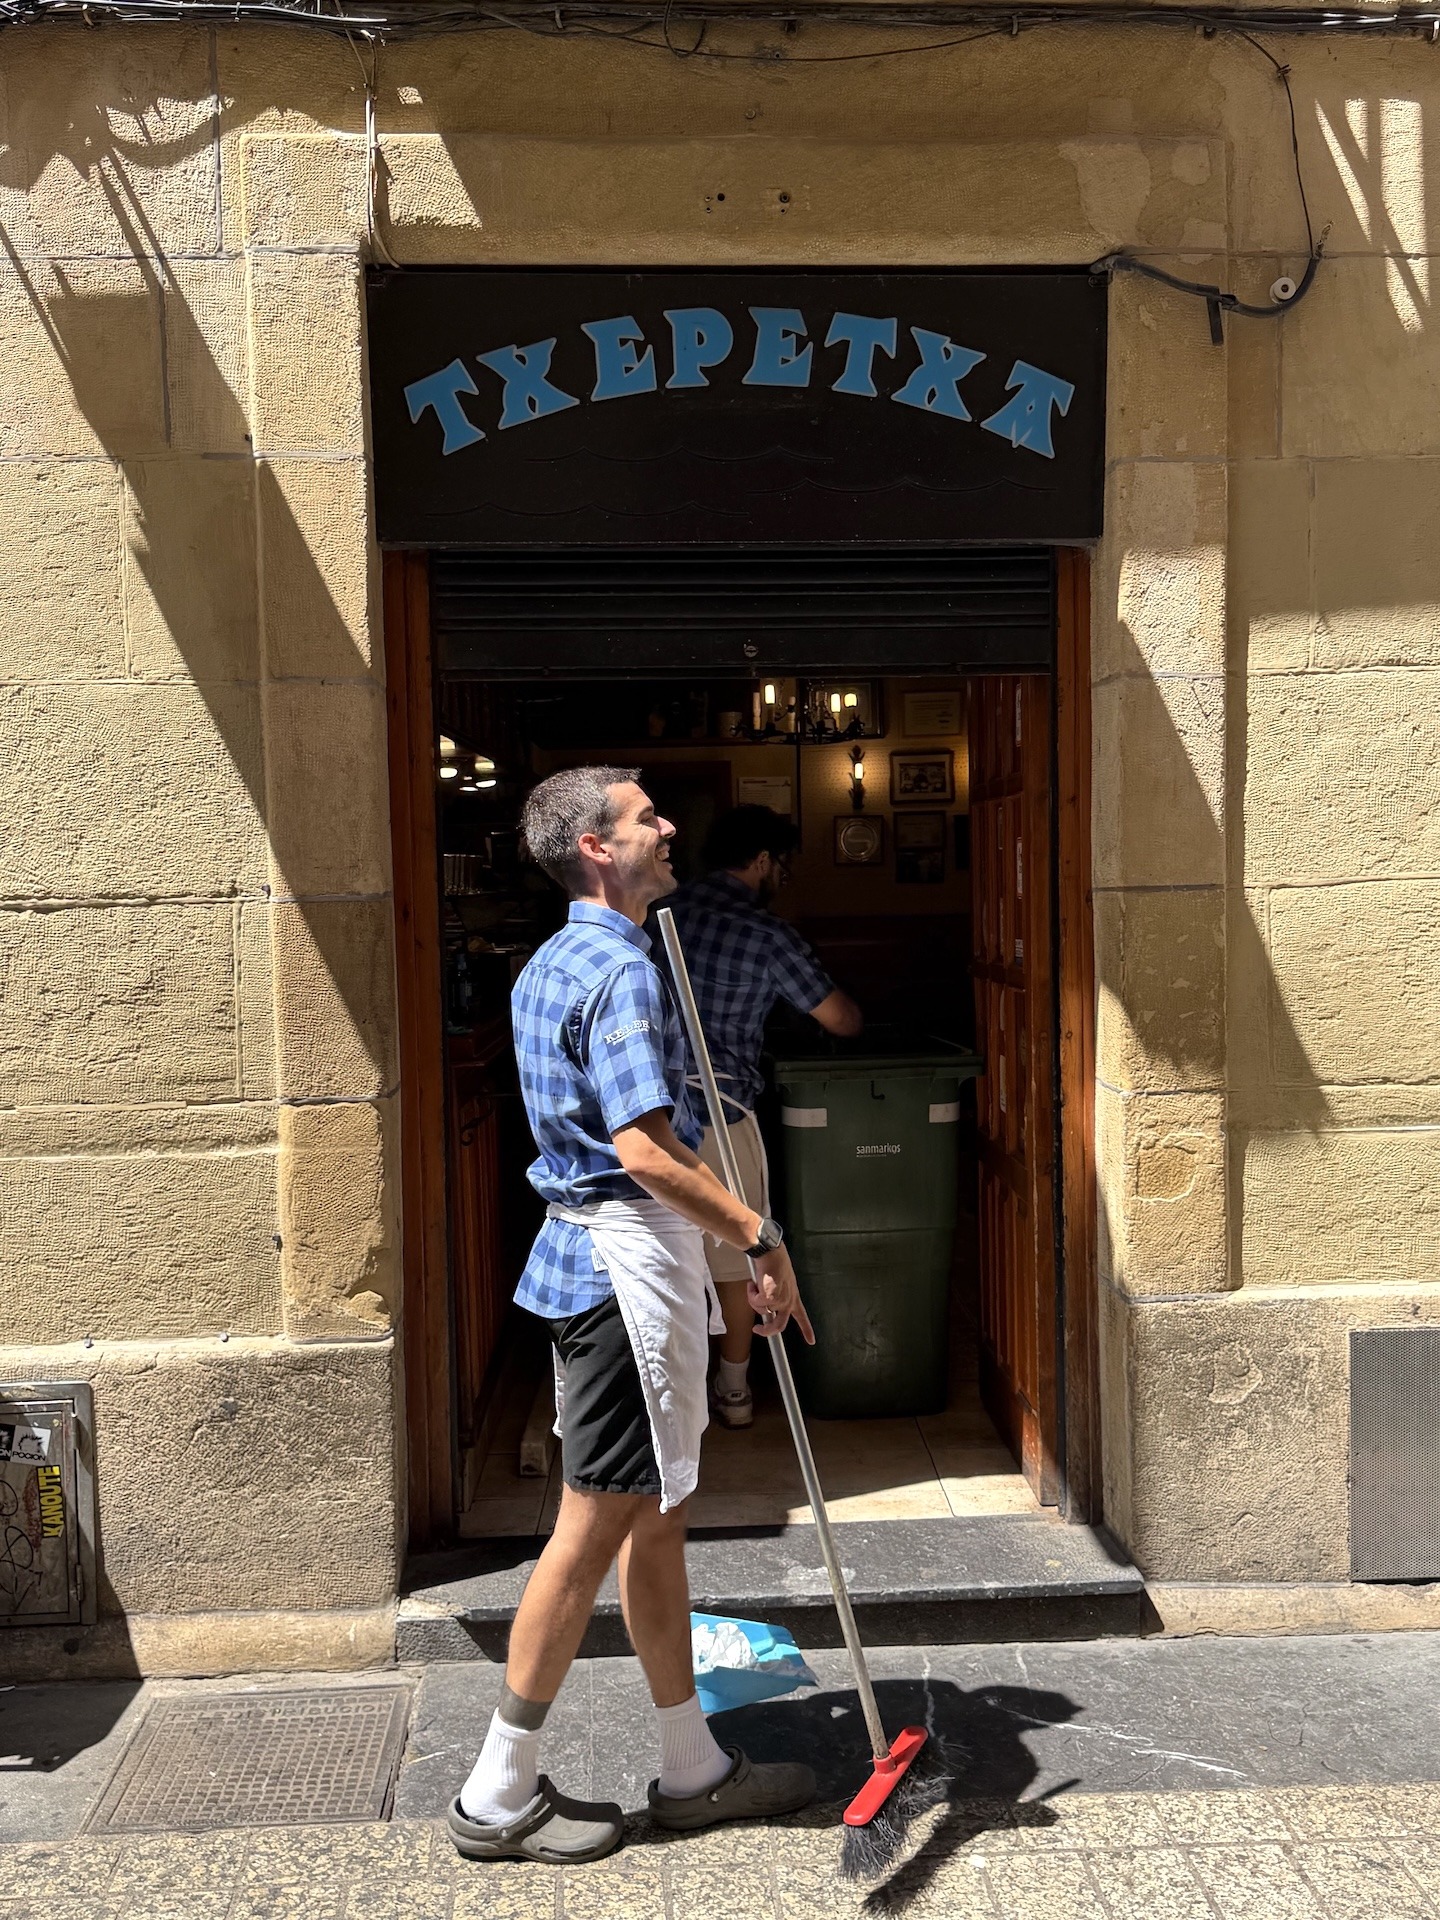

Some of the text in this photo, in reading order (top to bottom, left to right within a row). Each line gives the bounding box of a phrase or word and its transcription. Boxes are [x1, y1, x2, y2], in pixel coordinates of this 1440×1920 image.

[404, 306, 1076, 459] TXEPETXA
[603, 1019, 650, 1044] KELER
[856, 1142, 901, 1155] sanmarkos
[39, 1466, 63, 1537] KANOUTE
